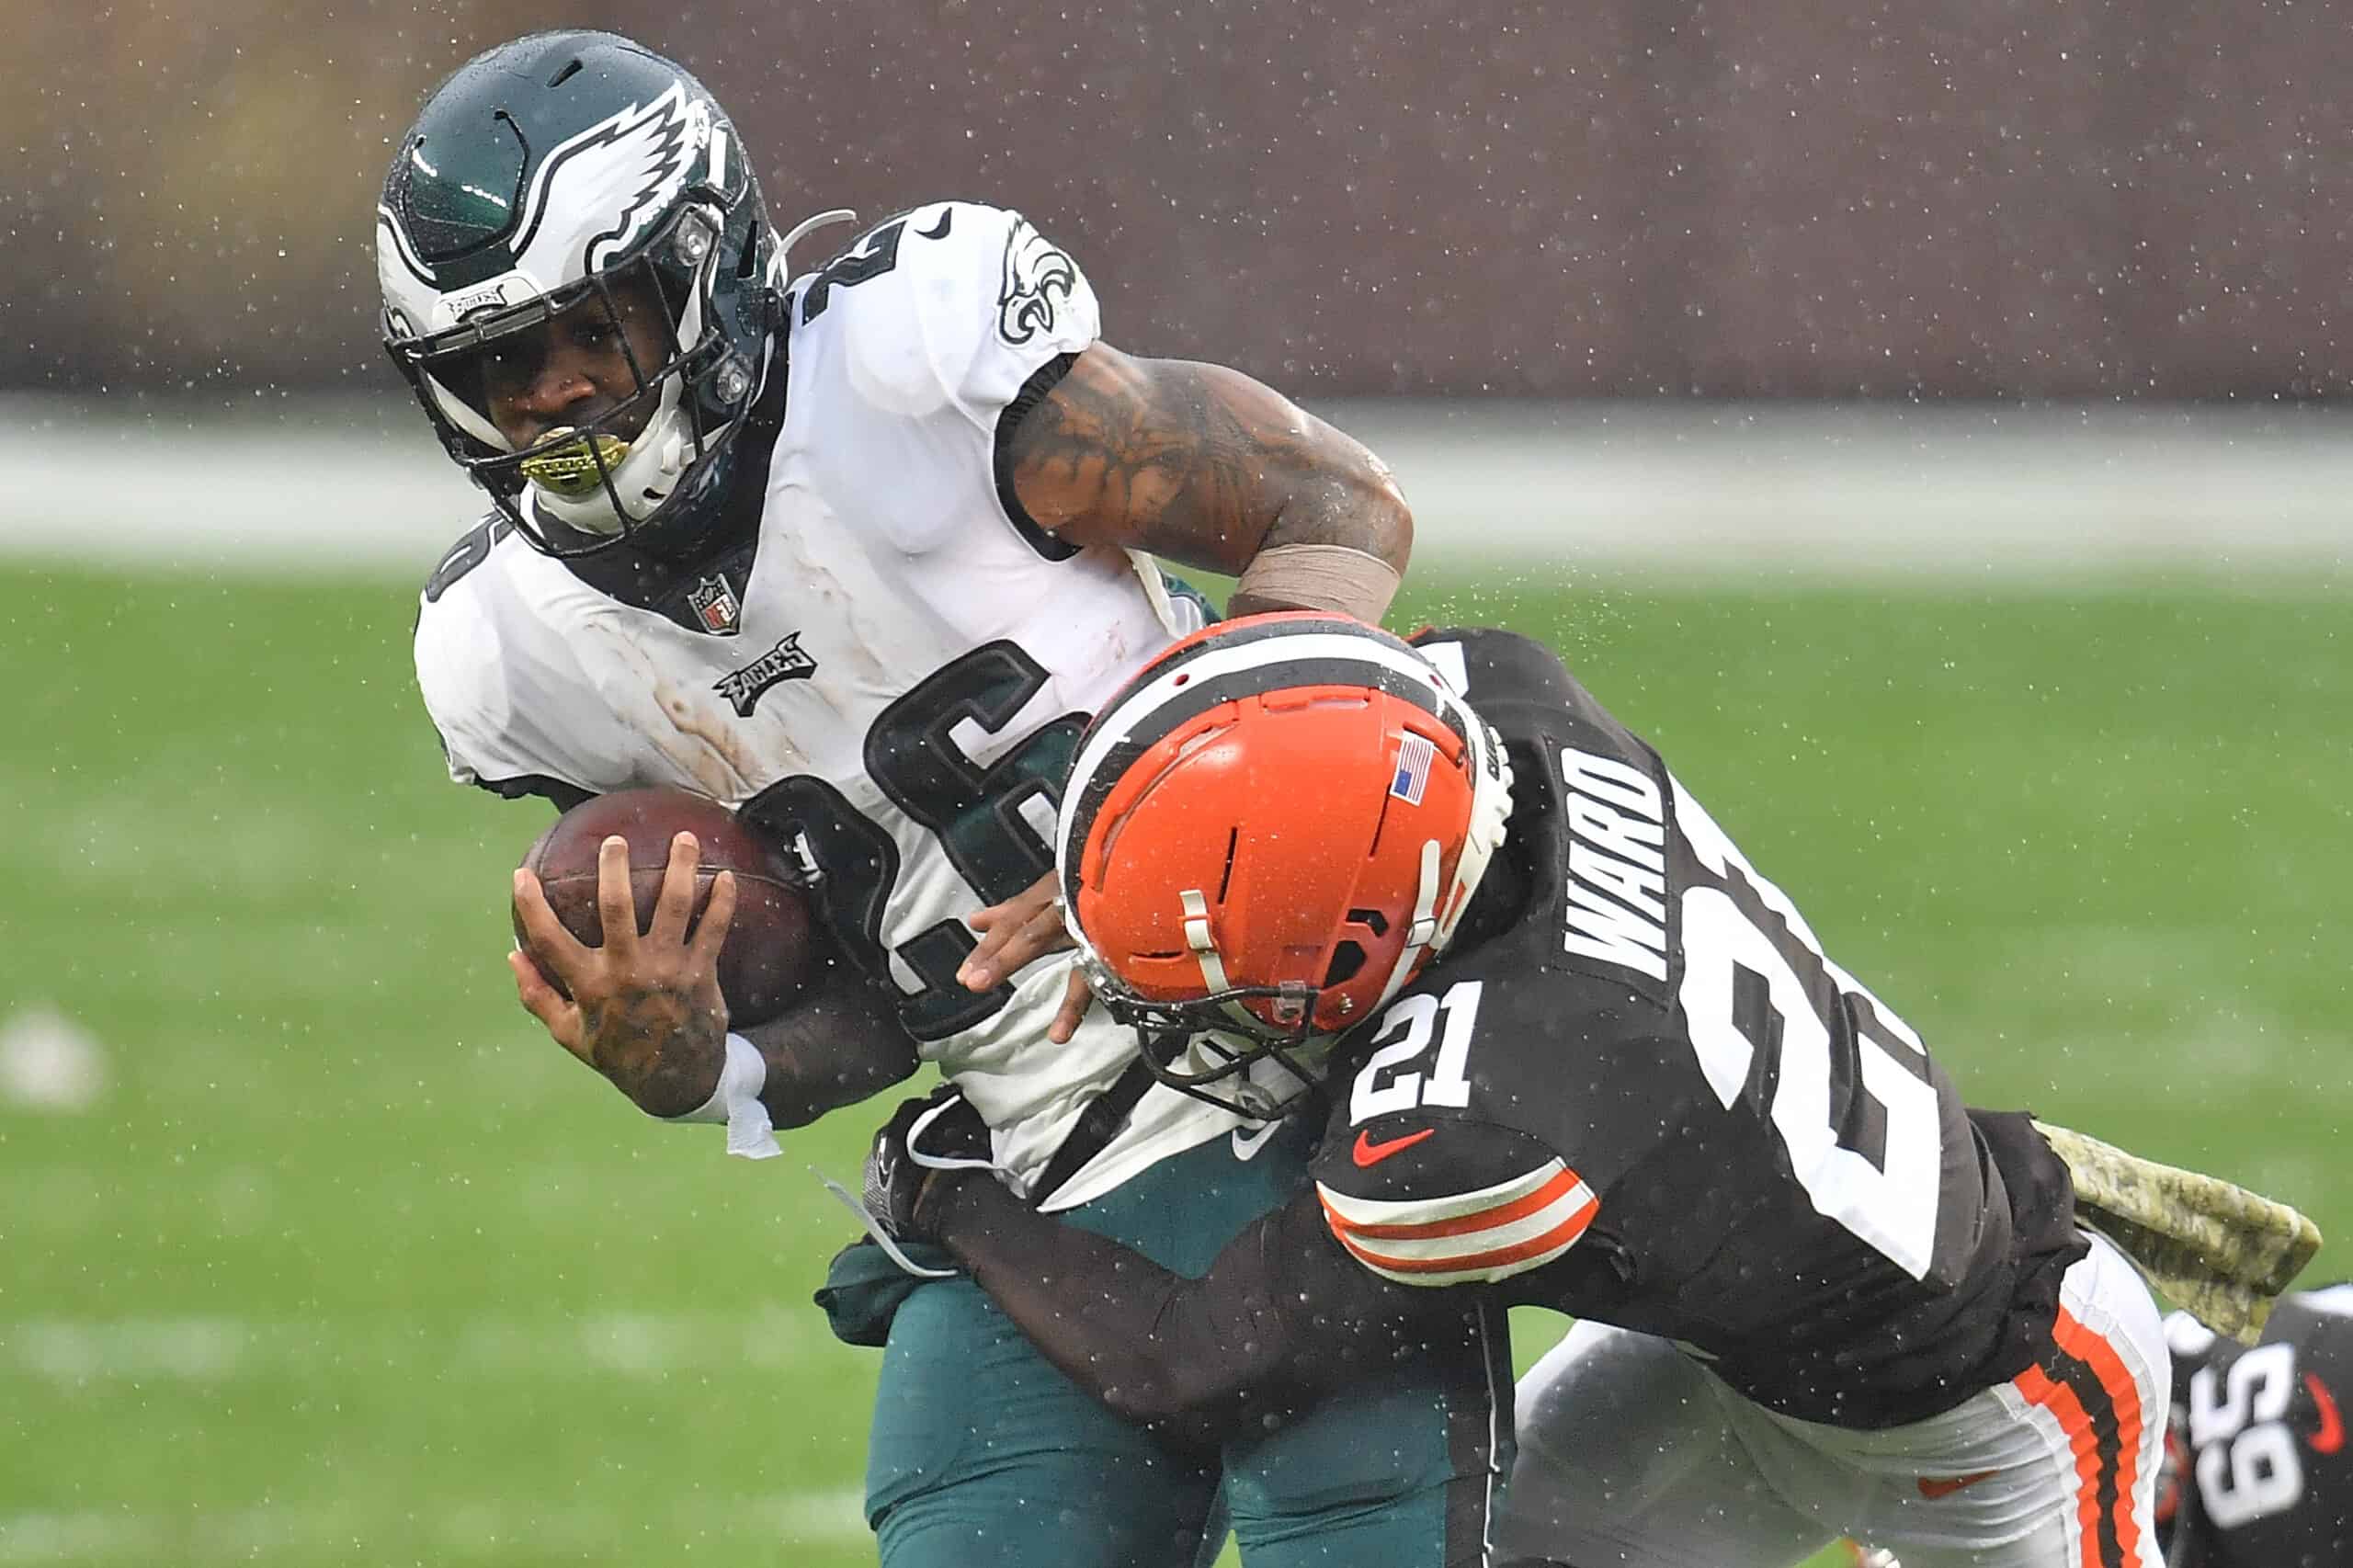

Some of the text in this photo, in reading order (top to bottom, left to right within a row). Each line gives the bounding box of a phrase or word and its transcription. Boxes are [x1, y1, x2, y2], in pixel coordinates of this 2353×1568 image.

[713, 631, 817, 714] EAGLES
[735, 639, 1101, 1043] 26
[1561, 747, 1668, 982] WARD
[1348, 980, 1483, 1127] 21
[1665, 767, 1941, 1282] 21
[2190, 1342, 2303, 1528] 65
